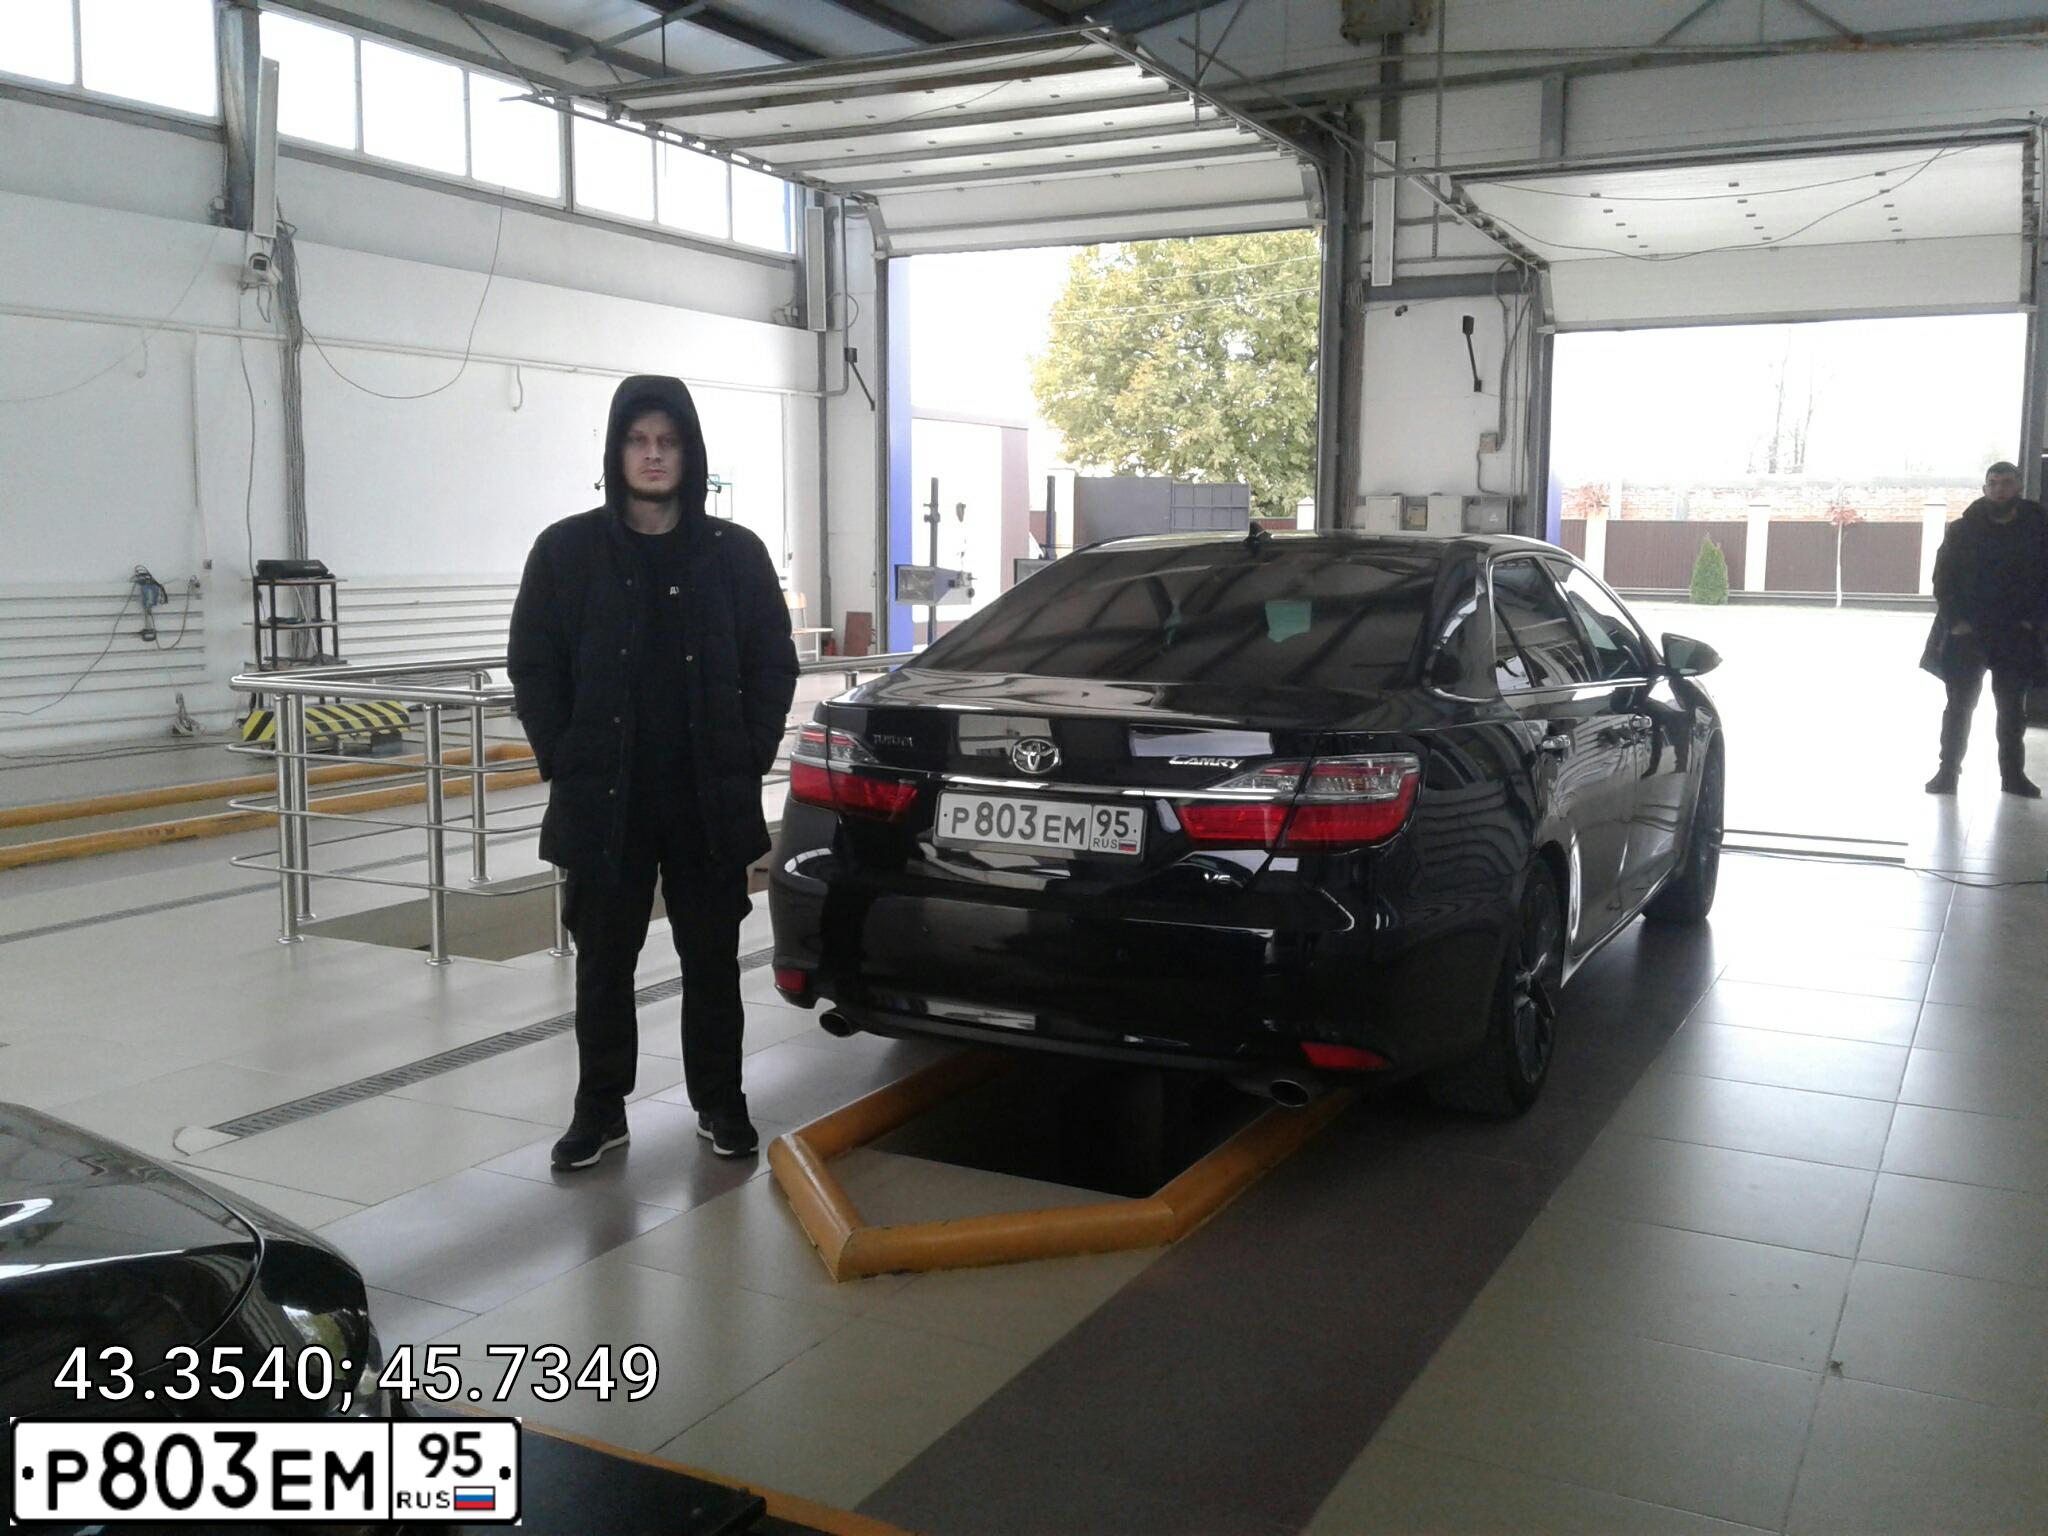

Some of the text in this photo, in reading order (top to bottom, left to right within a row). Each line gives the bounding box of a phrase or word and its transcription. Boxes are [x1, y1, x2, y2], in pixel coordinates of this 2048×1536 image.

[1168, 755, 1244, 769] CAMRY
[1096, 809, 1131, 838] 95
[1092, 838, 1118, 849] RUS
